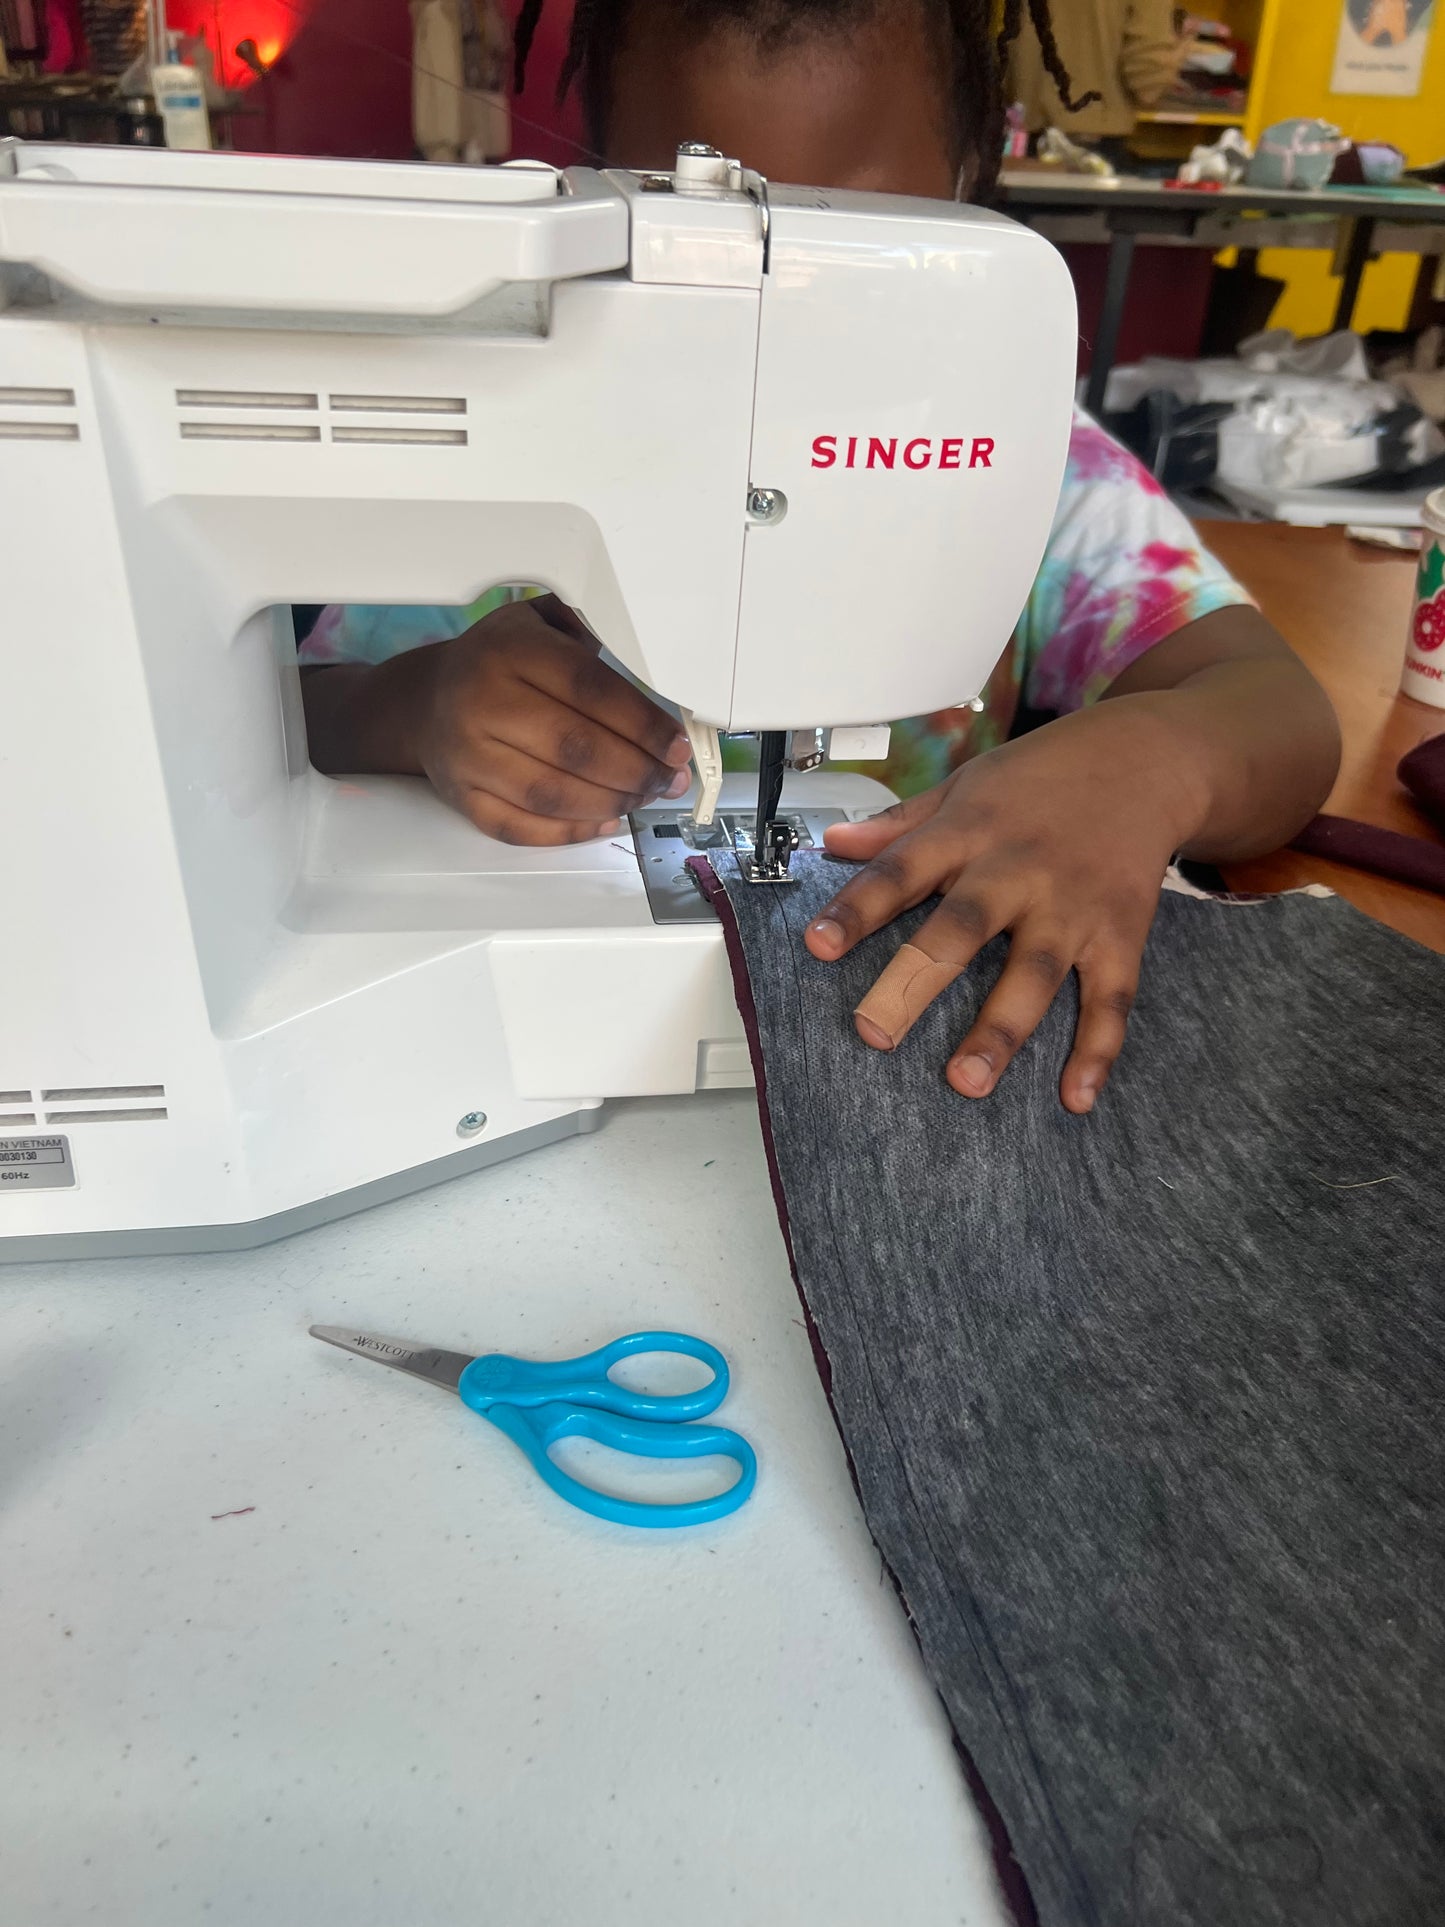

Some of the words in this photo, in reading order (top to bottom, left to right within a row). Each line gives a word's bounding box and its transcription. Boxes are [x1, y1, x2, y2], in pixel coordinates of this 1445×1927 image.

[810, 435, 995, 470] SINGER
[11, 1139, 62, 1148] VIETNAM
[1, 1172, 30, 1180] 60Hz
[354, 1335, 416, 1360] WESTCOTT
